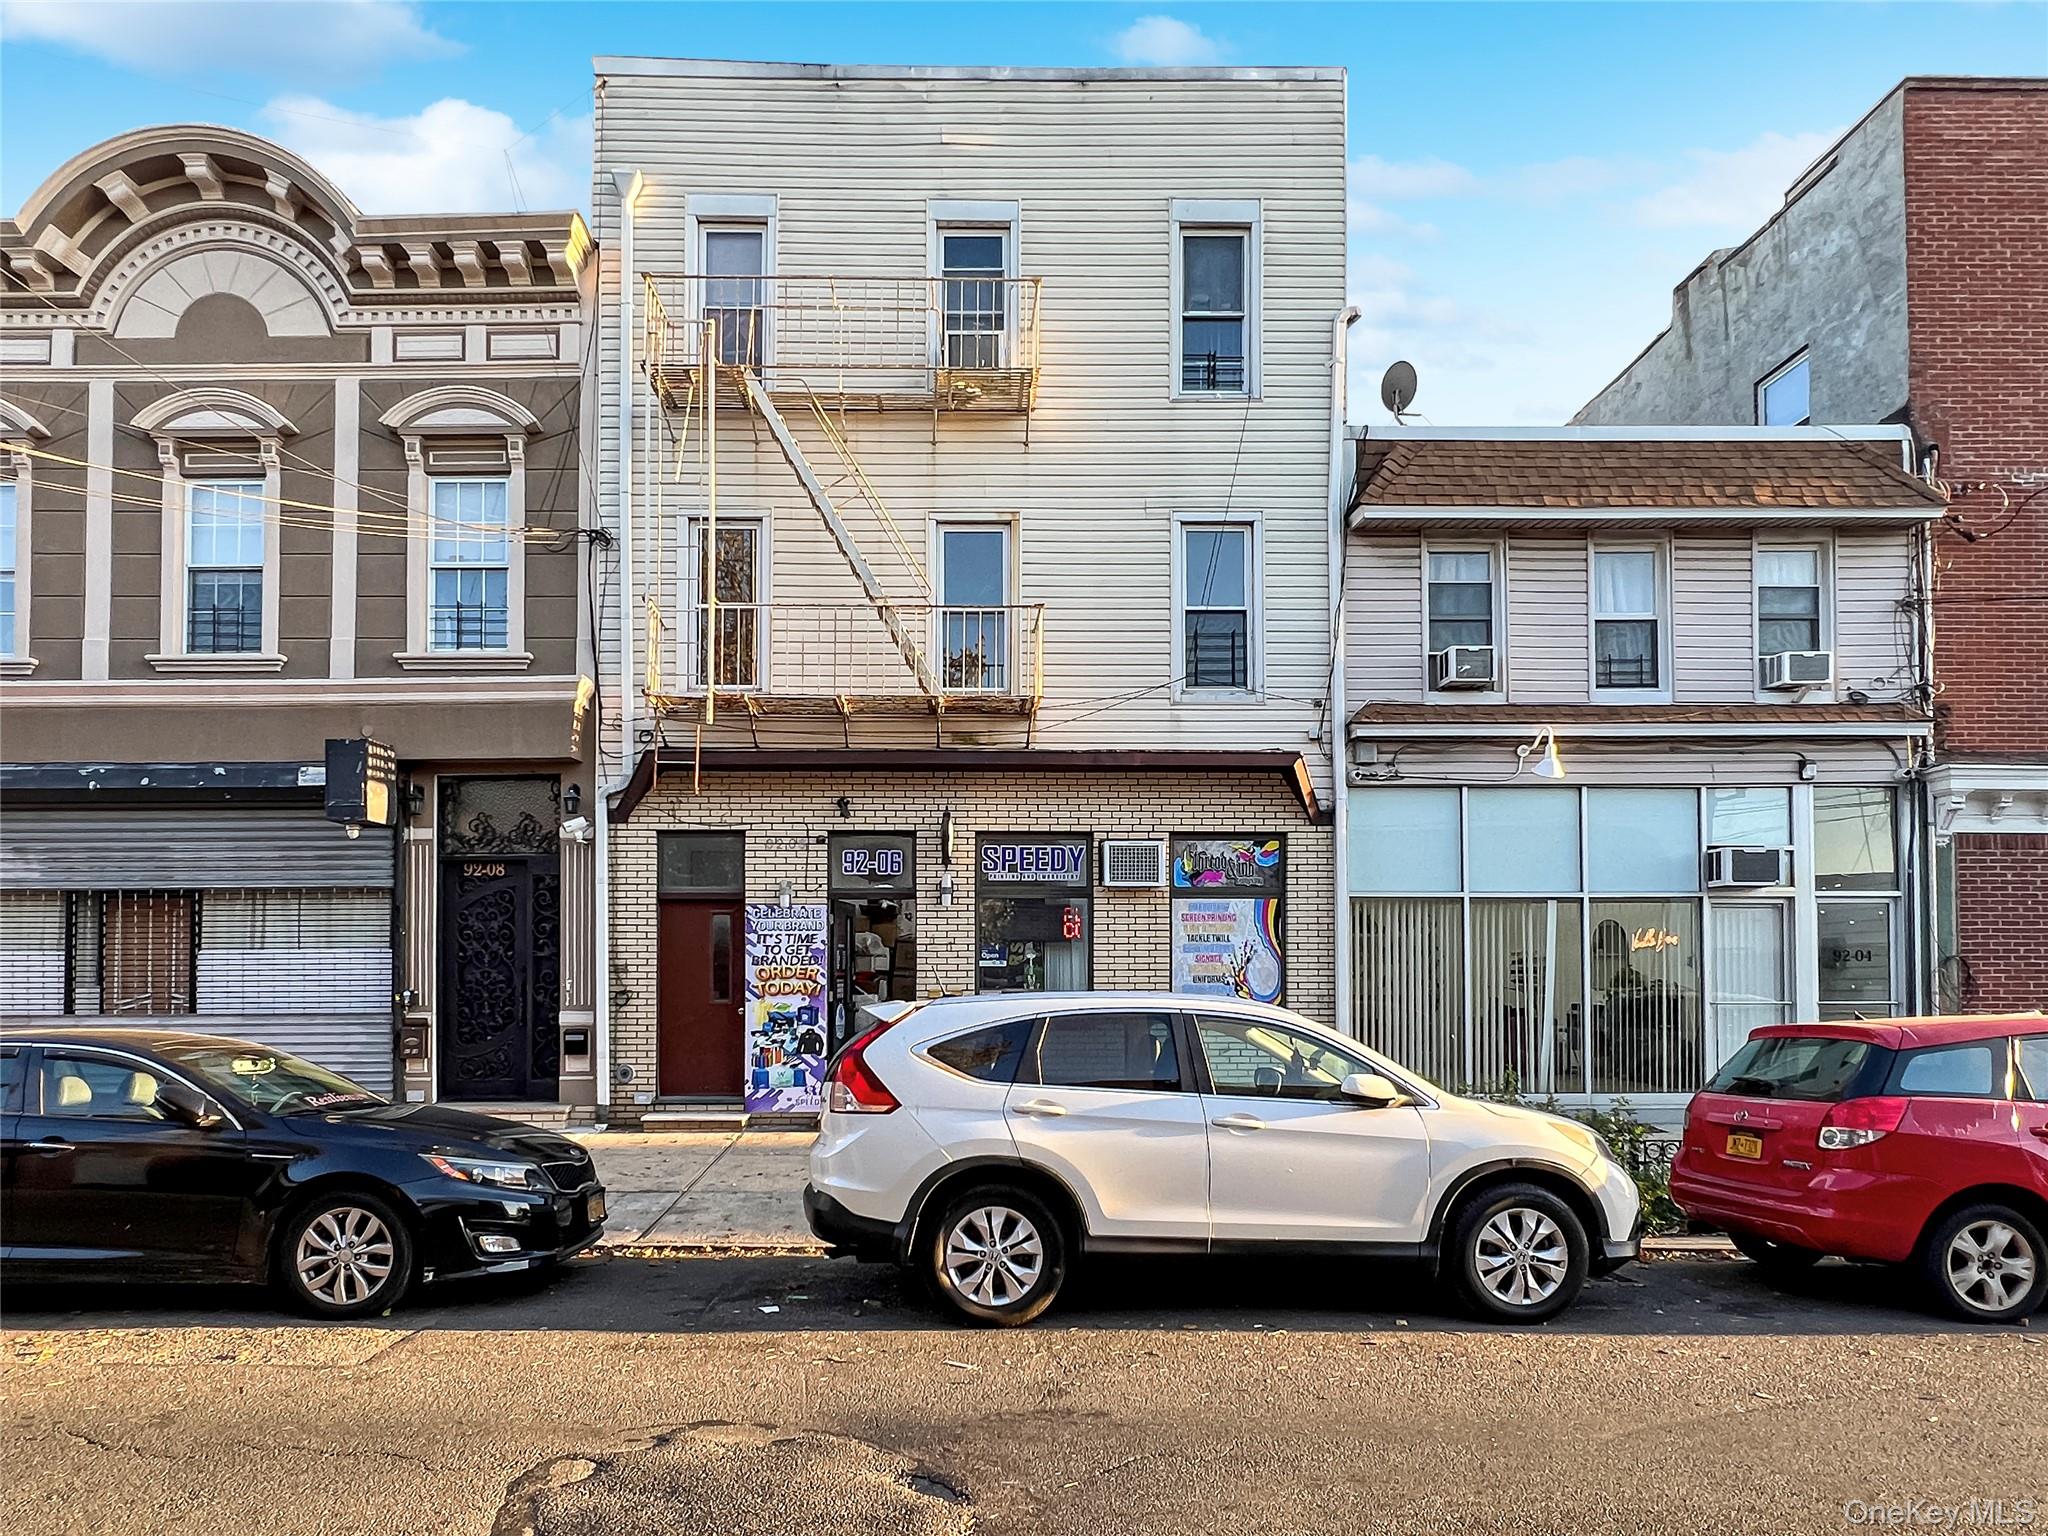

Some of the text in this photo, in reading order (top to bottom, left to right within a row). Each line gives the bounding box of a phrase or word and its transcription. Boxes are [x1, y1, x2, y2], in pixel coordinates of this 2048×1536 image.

[842, 850, 903, 875] 92-06
[981, 845, 1086, 873] SPEEDY
[463, 863, 505, 876] 92-08
[752, 908, 822, 919] CELEBRATE
[752, 920, 825, 932] YOUR BRAND
[756, 933, 819, 944] IT'S TIME
[762, 944, 812, 955] TO GET
[1832, 949, 1872, 962] 92-04
[751, 955, 824, 966] BRANDED!
[755, 966, 819, 981] ORDER
[754, 981, 822, 998] TODAY!
